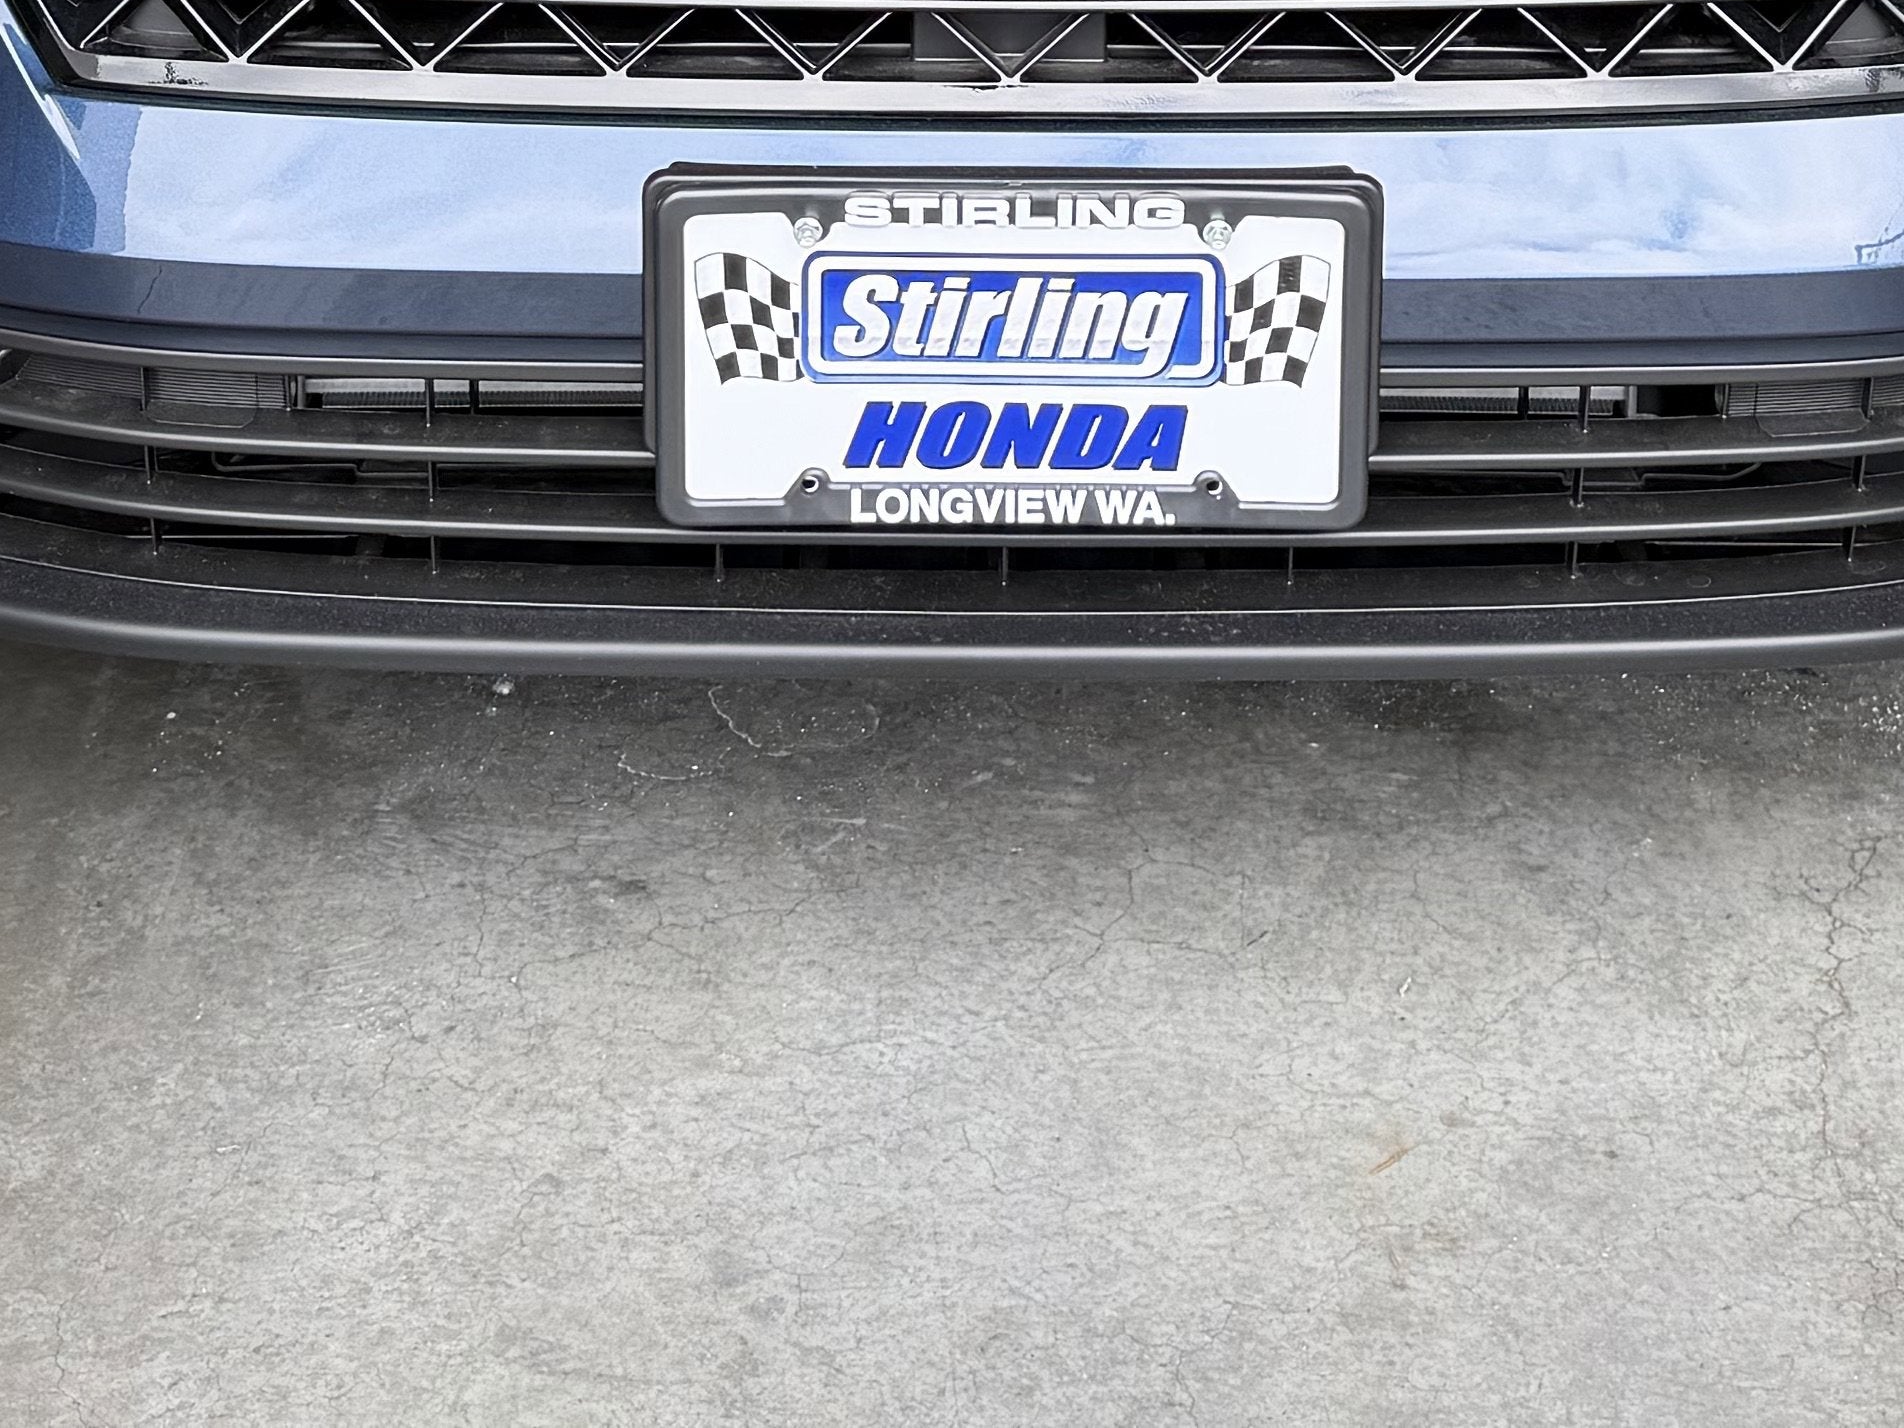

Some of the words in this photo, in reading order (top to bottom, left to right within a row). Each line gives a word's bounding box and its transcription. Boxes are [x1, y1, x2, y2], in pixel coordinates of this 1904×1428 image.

[843, 192, 1186, 229] STIRLING
[833, 273, 1191, 377] Stirling
[842, 400, 1189, 471] HONDA
[849, 488, 1088, 524] LONGVIEW
[1094, 488, 1176, 525] WA.
